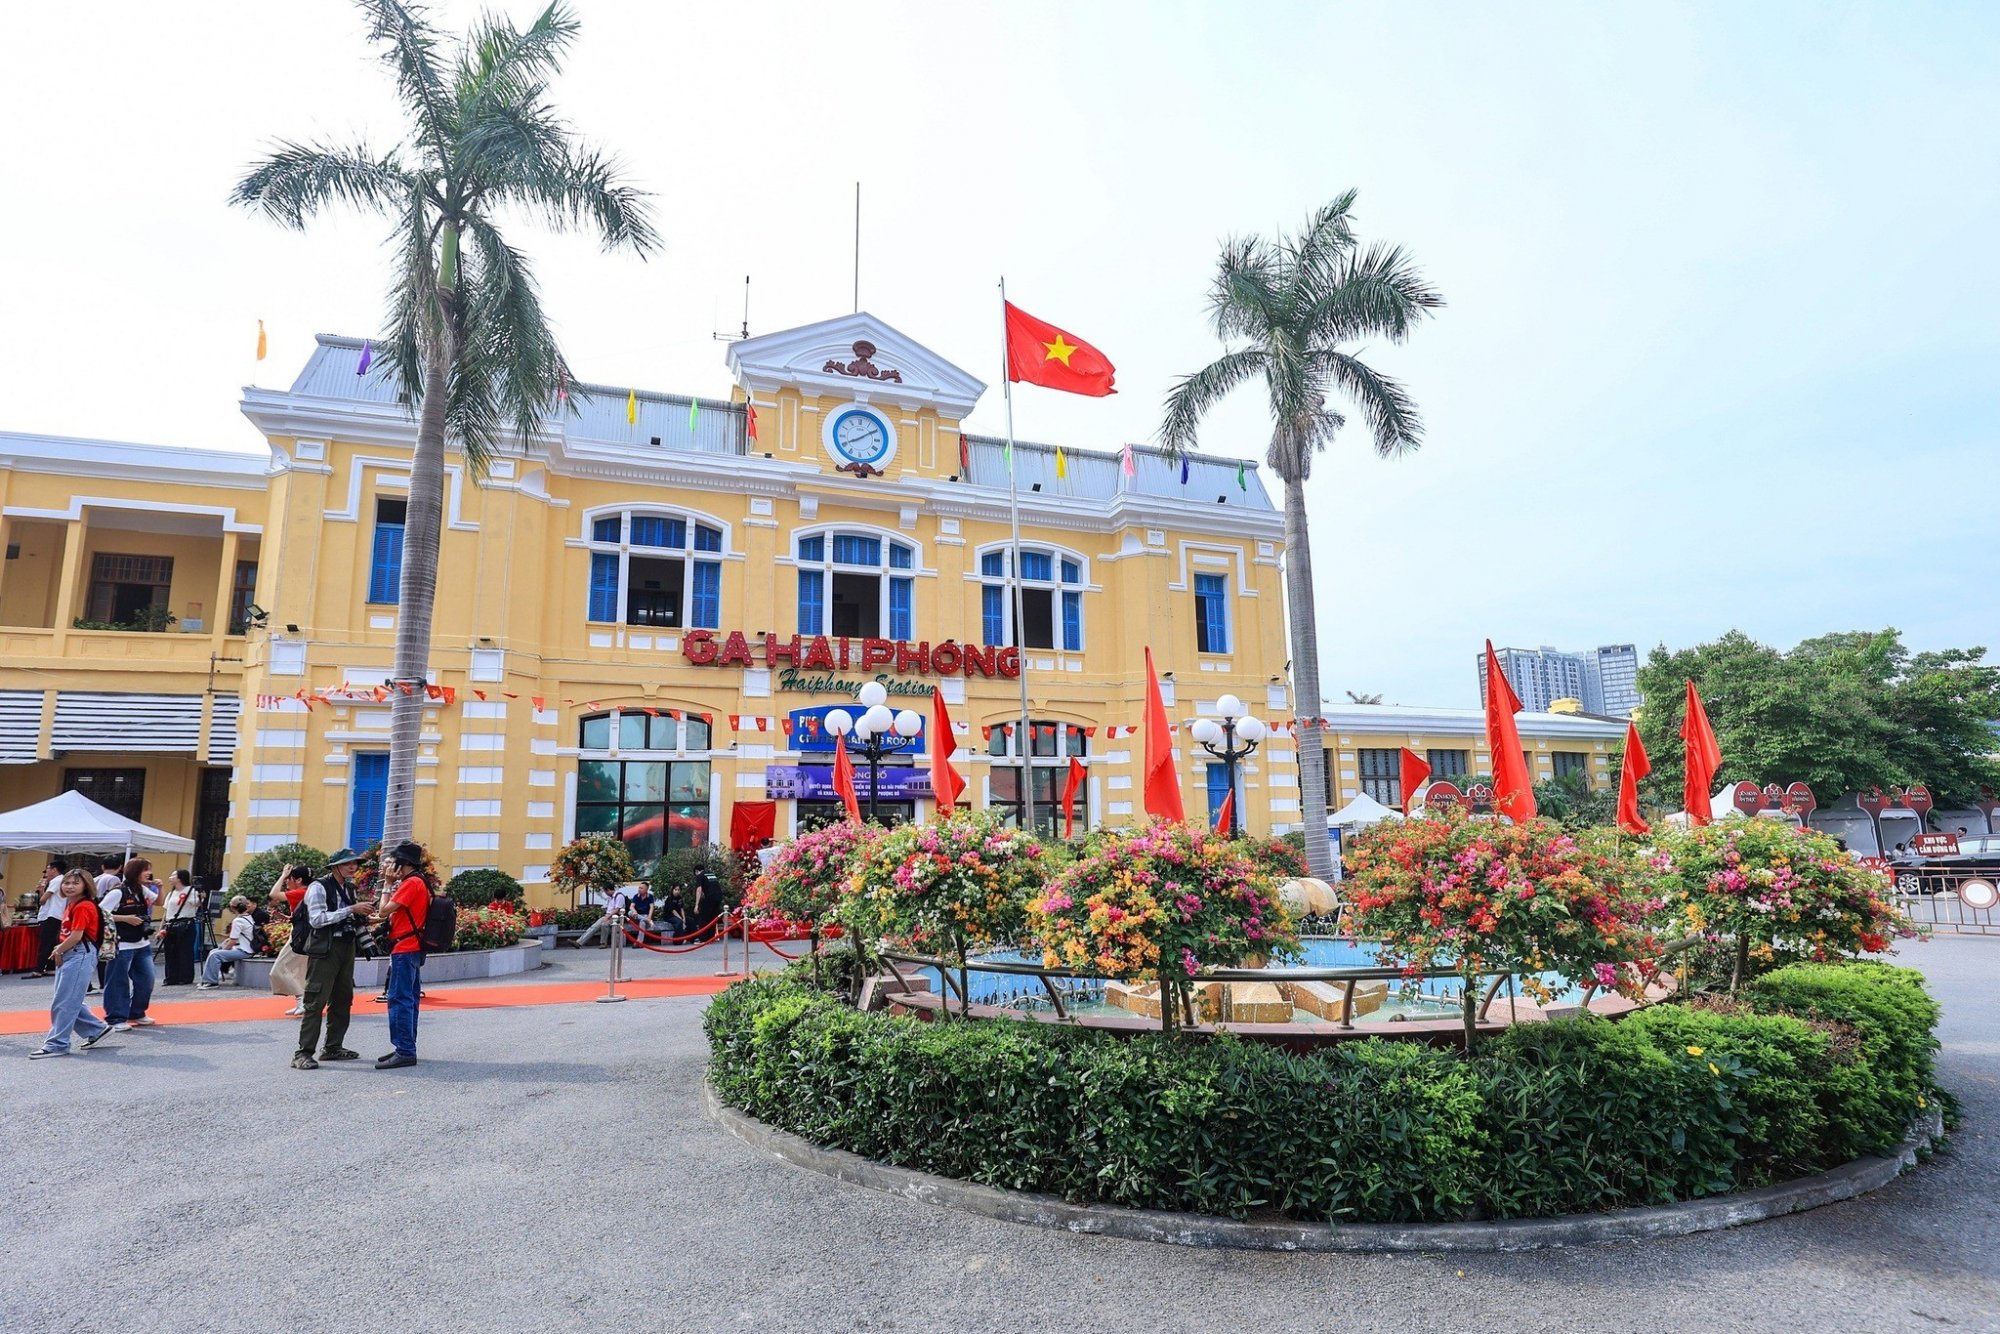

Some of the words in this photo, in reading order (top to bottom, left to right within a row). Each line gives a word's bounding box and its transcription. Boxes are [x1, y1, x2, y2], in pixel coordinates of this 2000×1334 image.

[682, 630, 754, 666] GA
[766, 633, 850, 670] HAI
[778, 668, 863, 698] Haiphong
[875, 674, 936, 696] Station
[886, 736, 916, 746] ROOM
